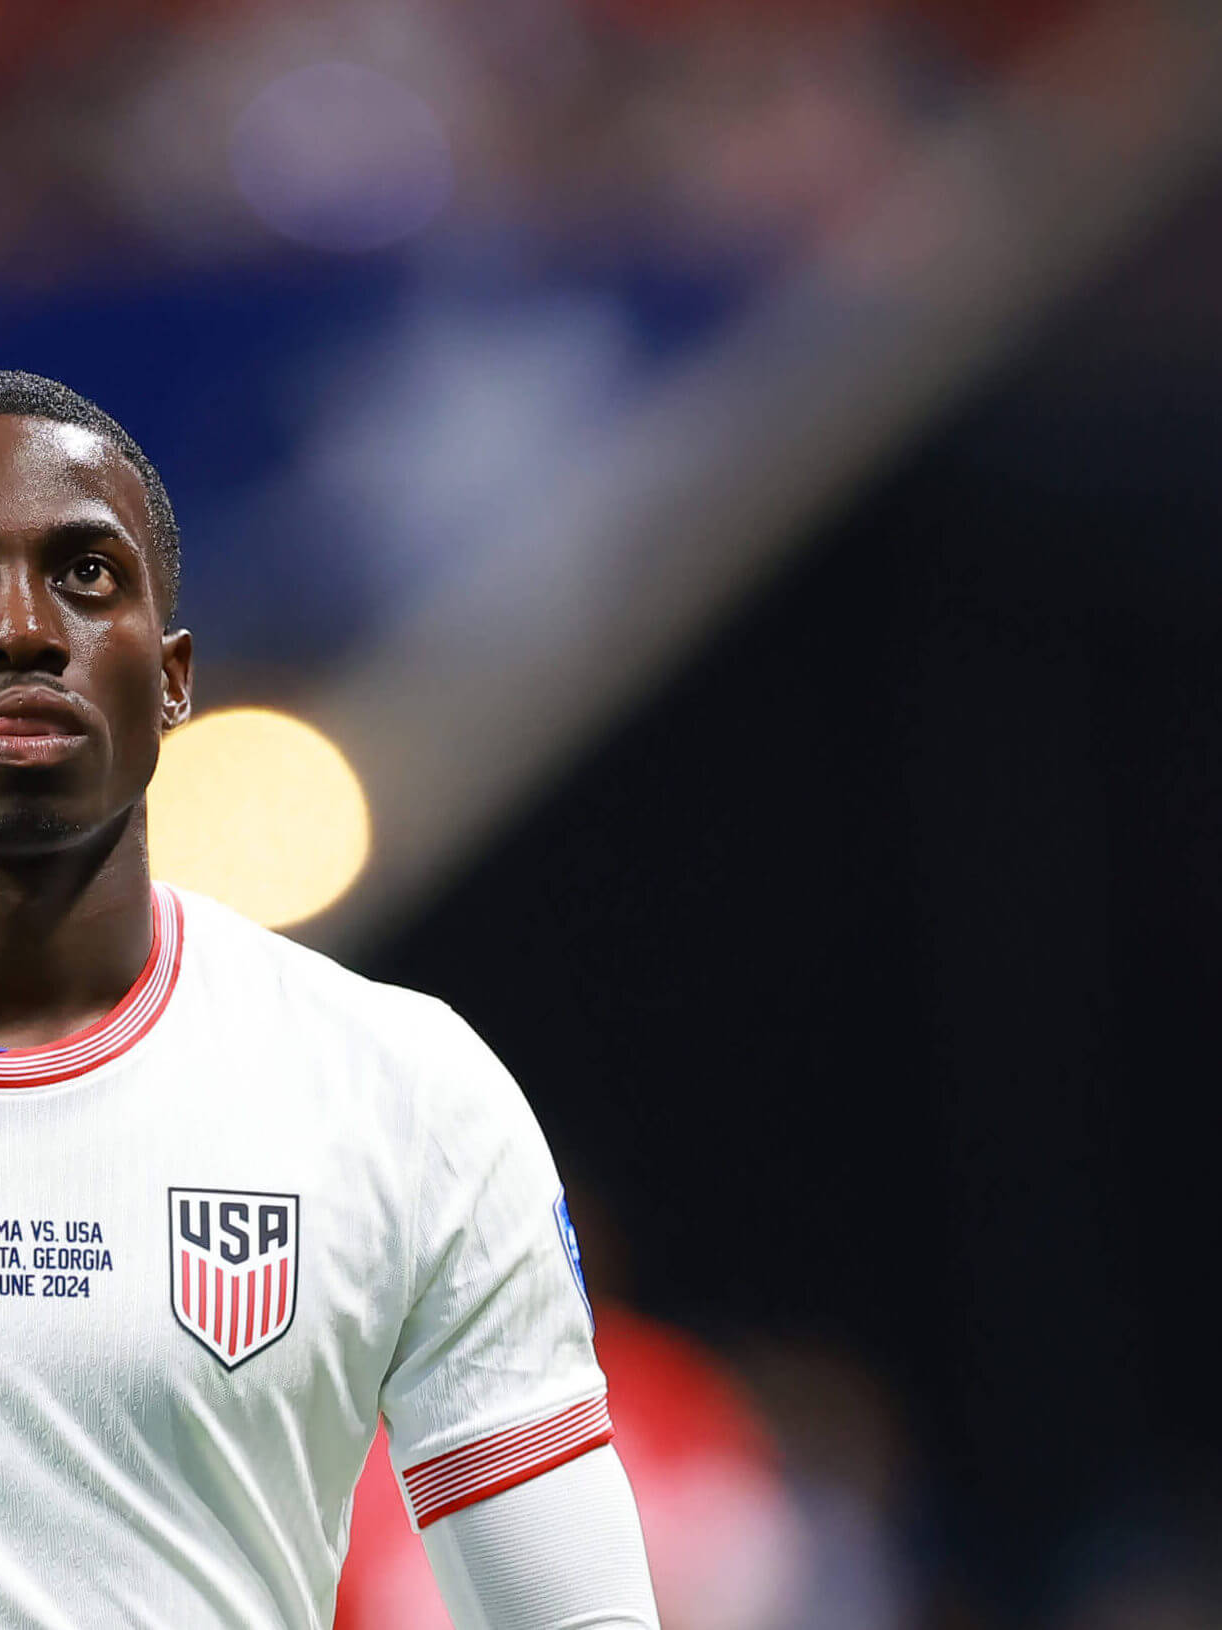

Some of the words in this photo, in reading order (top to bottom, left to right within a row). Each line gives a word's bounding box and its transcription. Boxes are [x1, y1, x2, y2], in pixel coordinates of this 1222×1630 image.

[30, 1219, 59, 1243] VS.
[65, 1221, 103, 1244] USA
[179, 1199, 289, 1265] USA
[33, 1247, 113, 1271] GEORGIA
[42, 1274, 90, 1299] 2024
